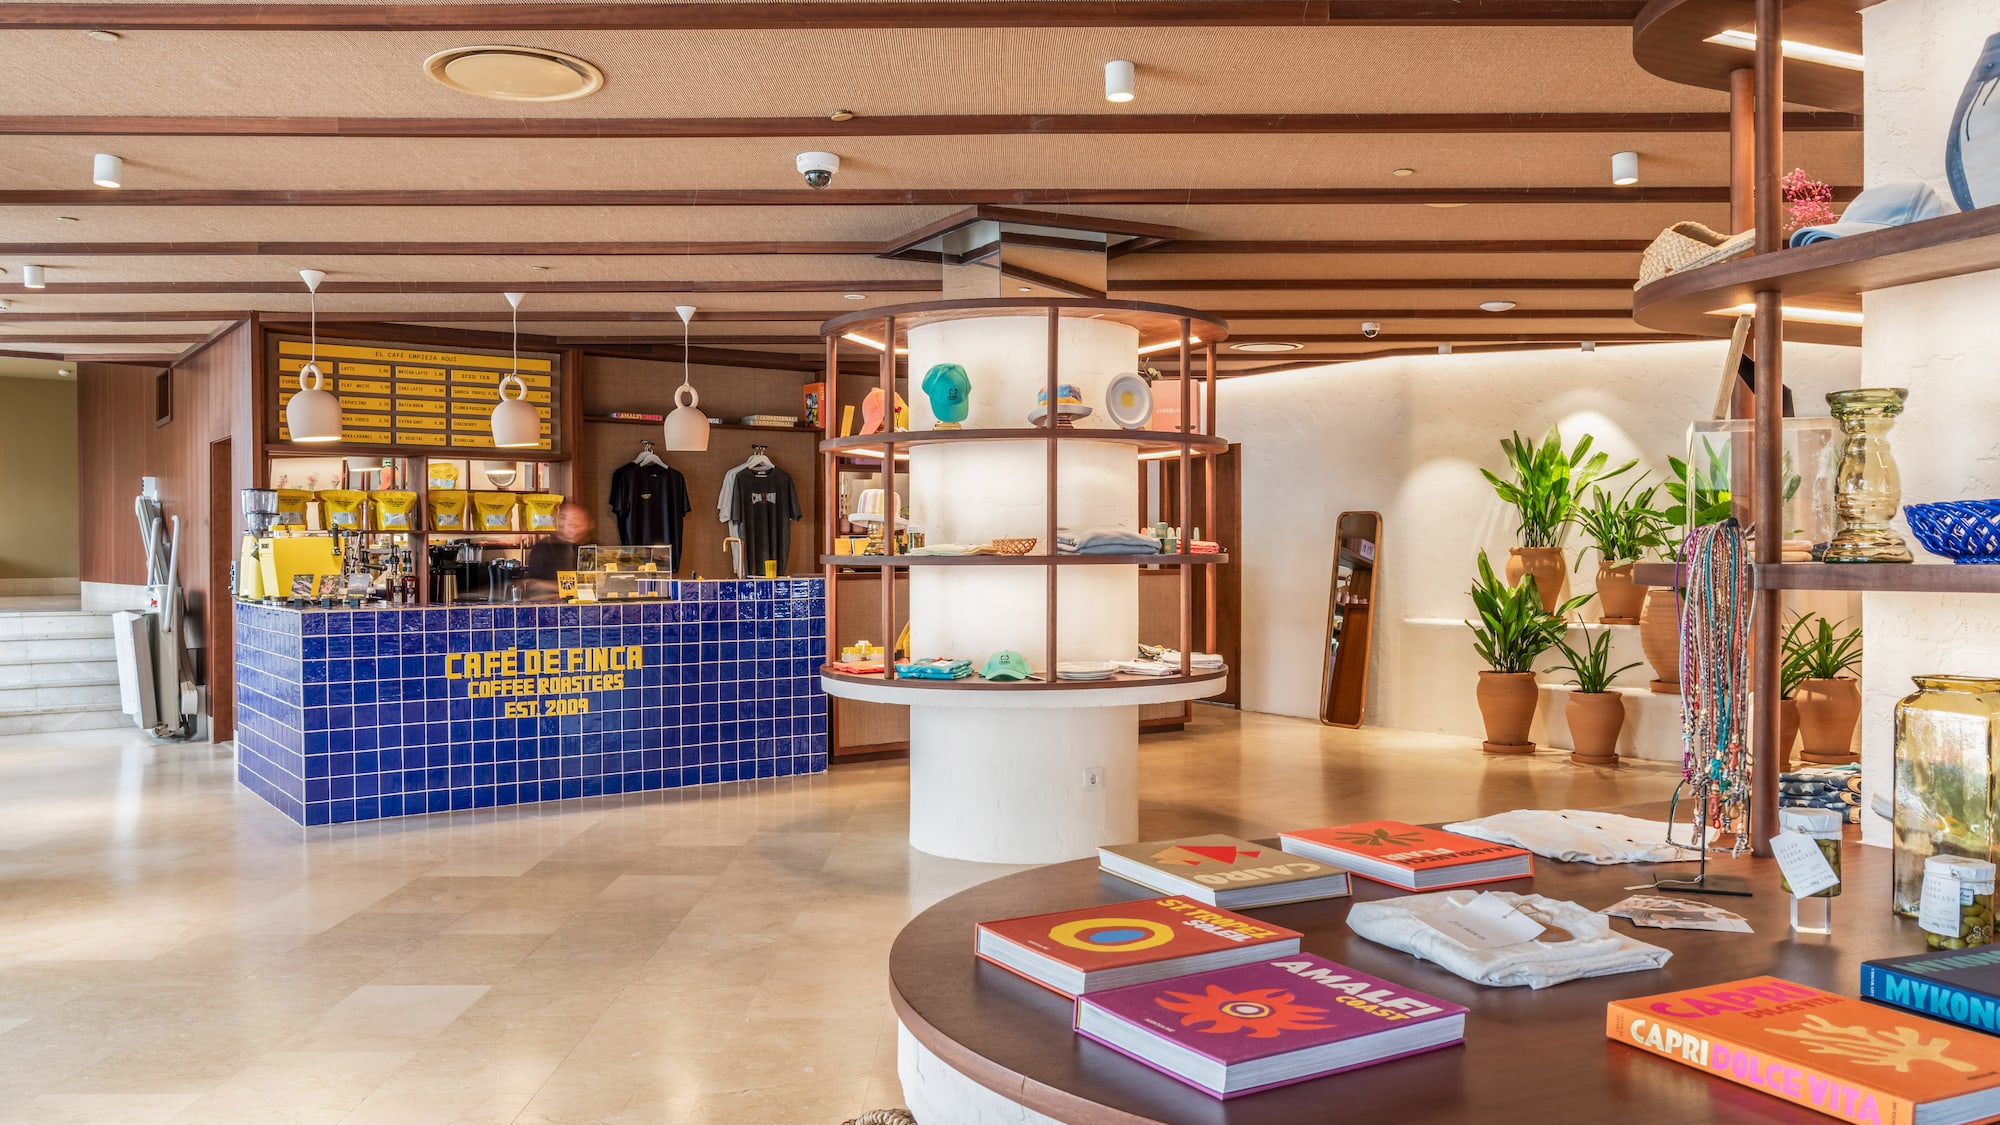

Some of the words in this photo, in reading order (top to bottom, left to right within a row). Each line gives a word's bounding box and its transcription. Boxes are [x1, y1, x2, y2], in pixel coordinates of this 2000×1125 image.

[387, 351, 405, 359] CAFÉ
[408, 353, 438, 361] EMPIEZA
[445, 647, 517, 680] CAFÉ
[524, 649, 561, 676] DE
[568, 645, 643, 673] FINCA
[468, 677, 535, 698] COFFEE
[539, 673, 625, 694] ROASTERS
[505, 701, 541, 718] EST.
[545, 698, 589, 717] 2009
[1381, 847, 1455, 861] FLAIR
[1193, 863, 1321, 885] CAIRO
[1156, 899, 1196, 912] ST.
[1184, 909, 1280, 939] TROPEZ
[1182, 919, 1252, 942] SOLEIL
[1269, 961, 1444, 1018] AMALFI
[1650, 981, 1821, 1018] CAPRI
[1335, 995, 1411, 1021] COAST
[1742, 1003, 1805, 1019] DOLCE
[1794, 996, 1846, 1008] VITA
[1630, 1018, 1710, 1067] CAPRI
[1711, 1043, 1804, 1099] DOLCE
[1808, 1073, 1882, 1125] VITA
